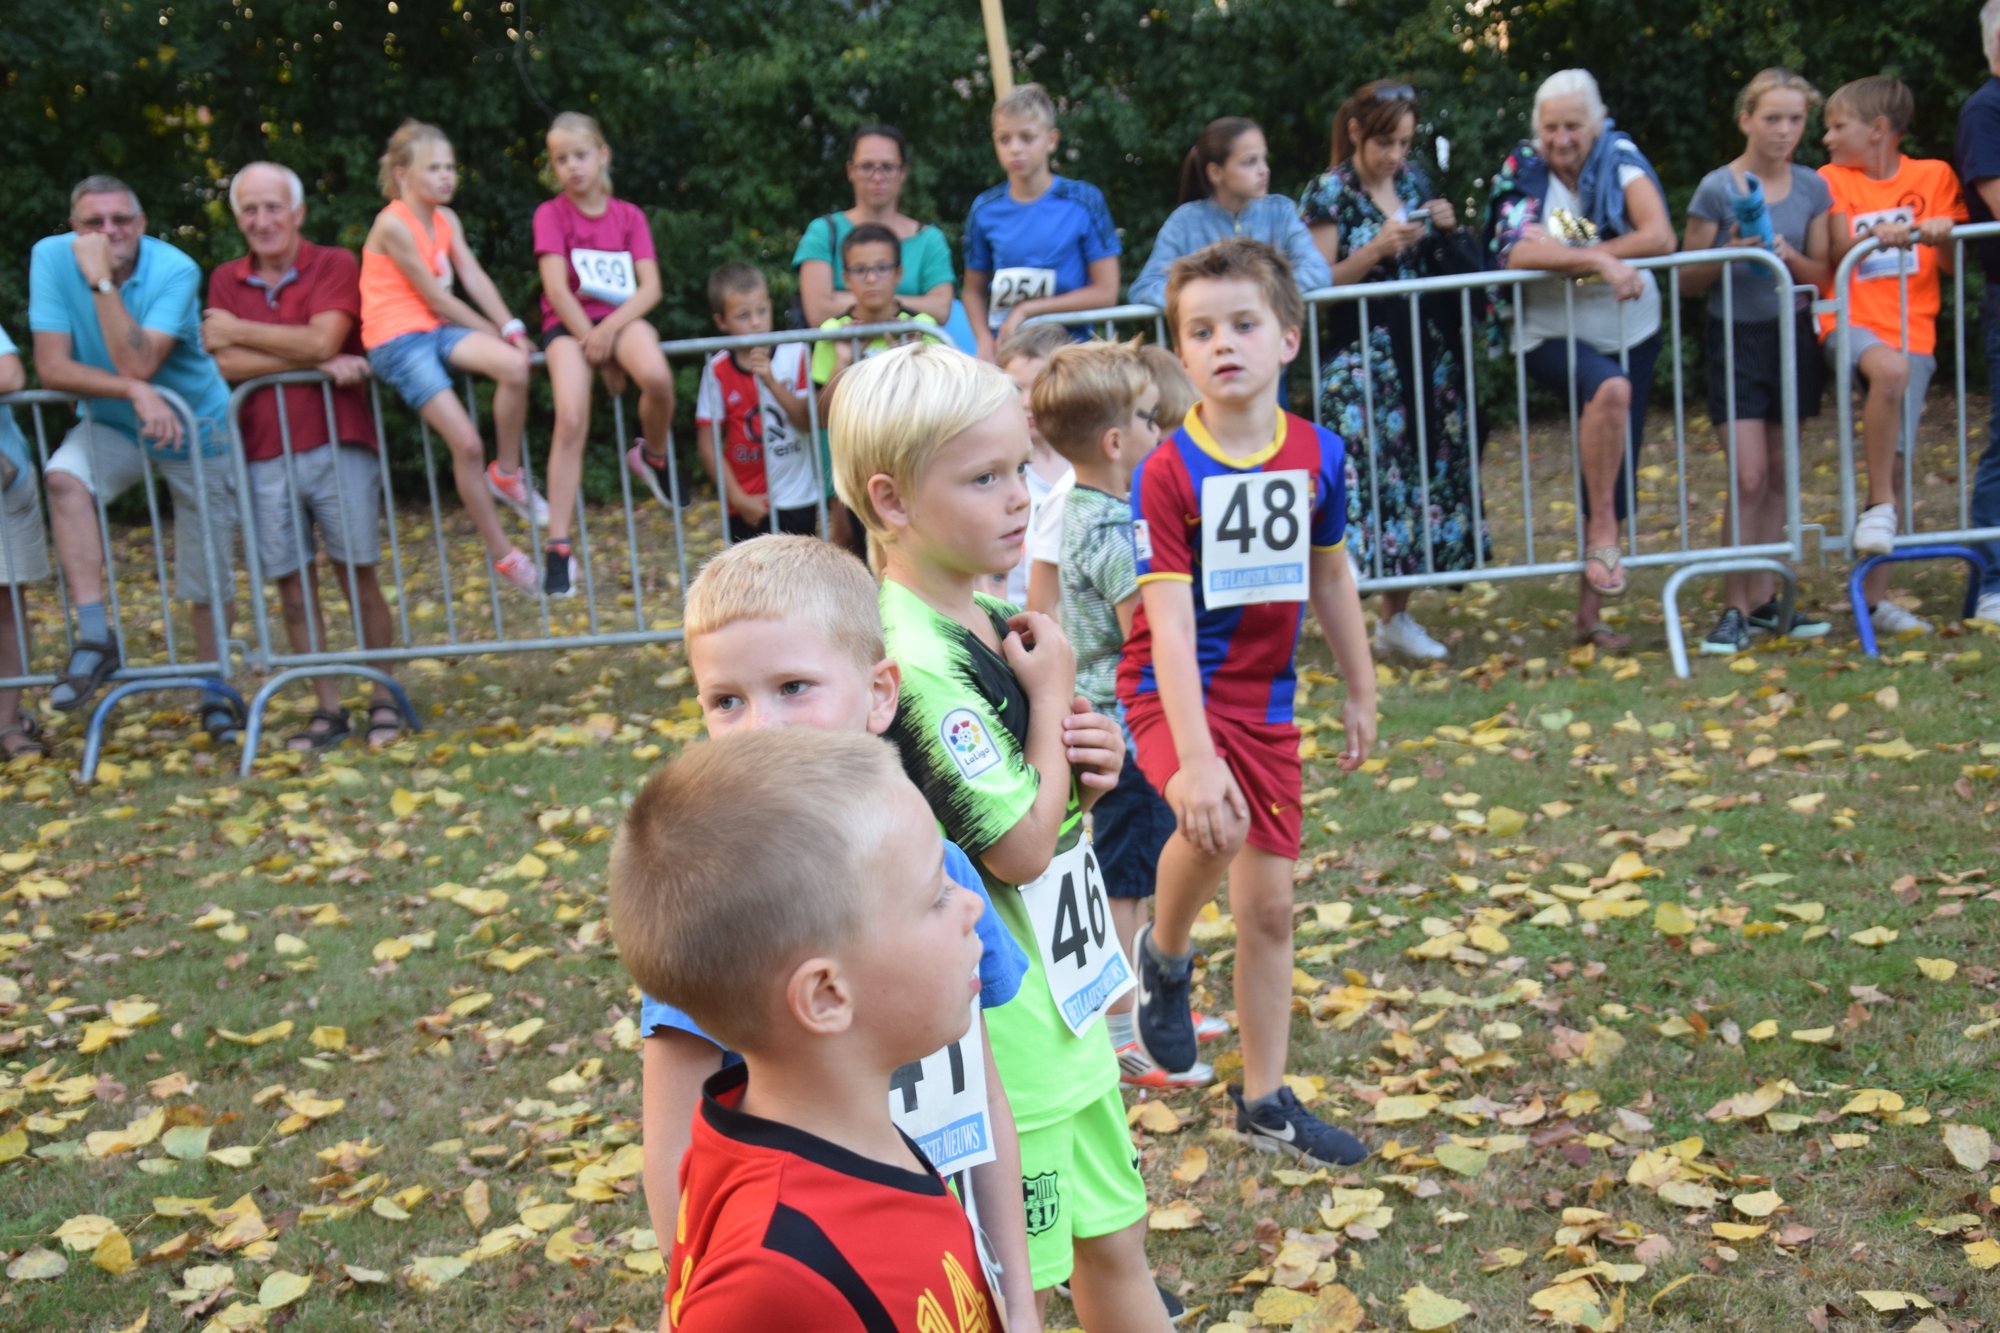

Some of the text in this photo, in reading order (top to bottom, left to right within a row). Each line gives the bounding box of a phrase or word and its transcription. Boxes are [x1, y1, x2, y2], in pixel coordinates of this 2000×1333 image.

[580, 256, 626, 288] 169
[996, 277, 1048, 308] 254
[1216, 478, 1299, 553] 48
[963, 747, 990, 766] LaLiga
[1052, 852, 1105, 970] 46
[941, 1121, 980, 1162] NIEUWS
